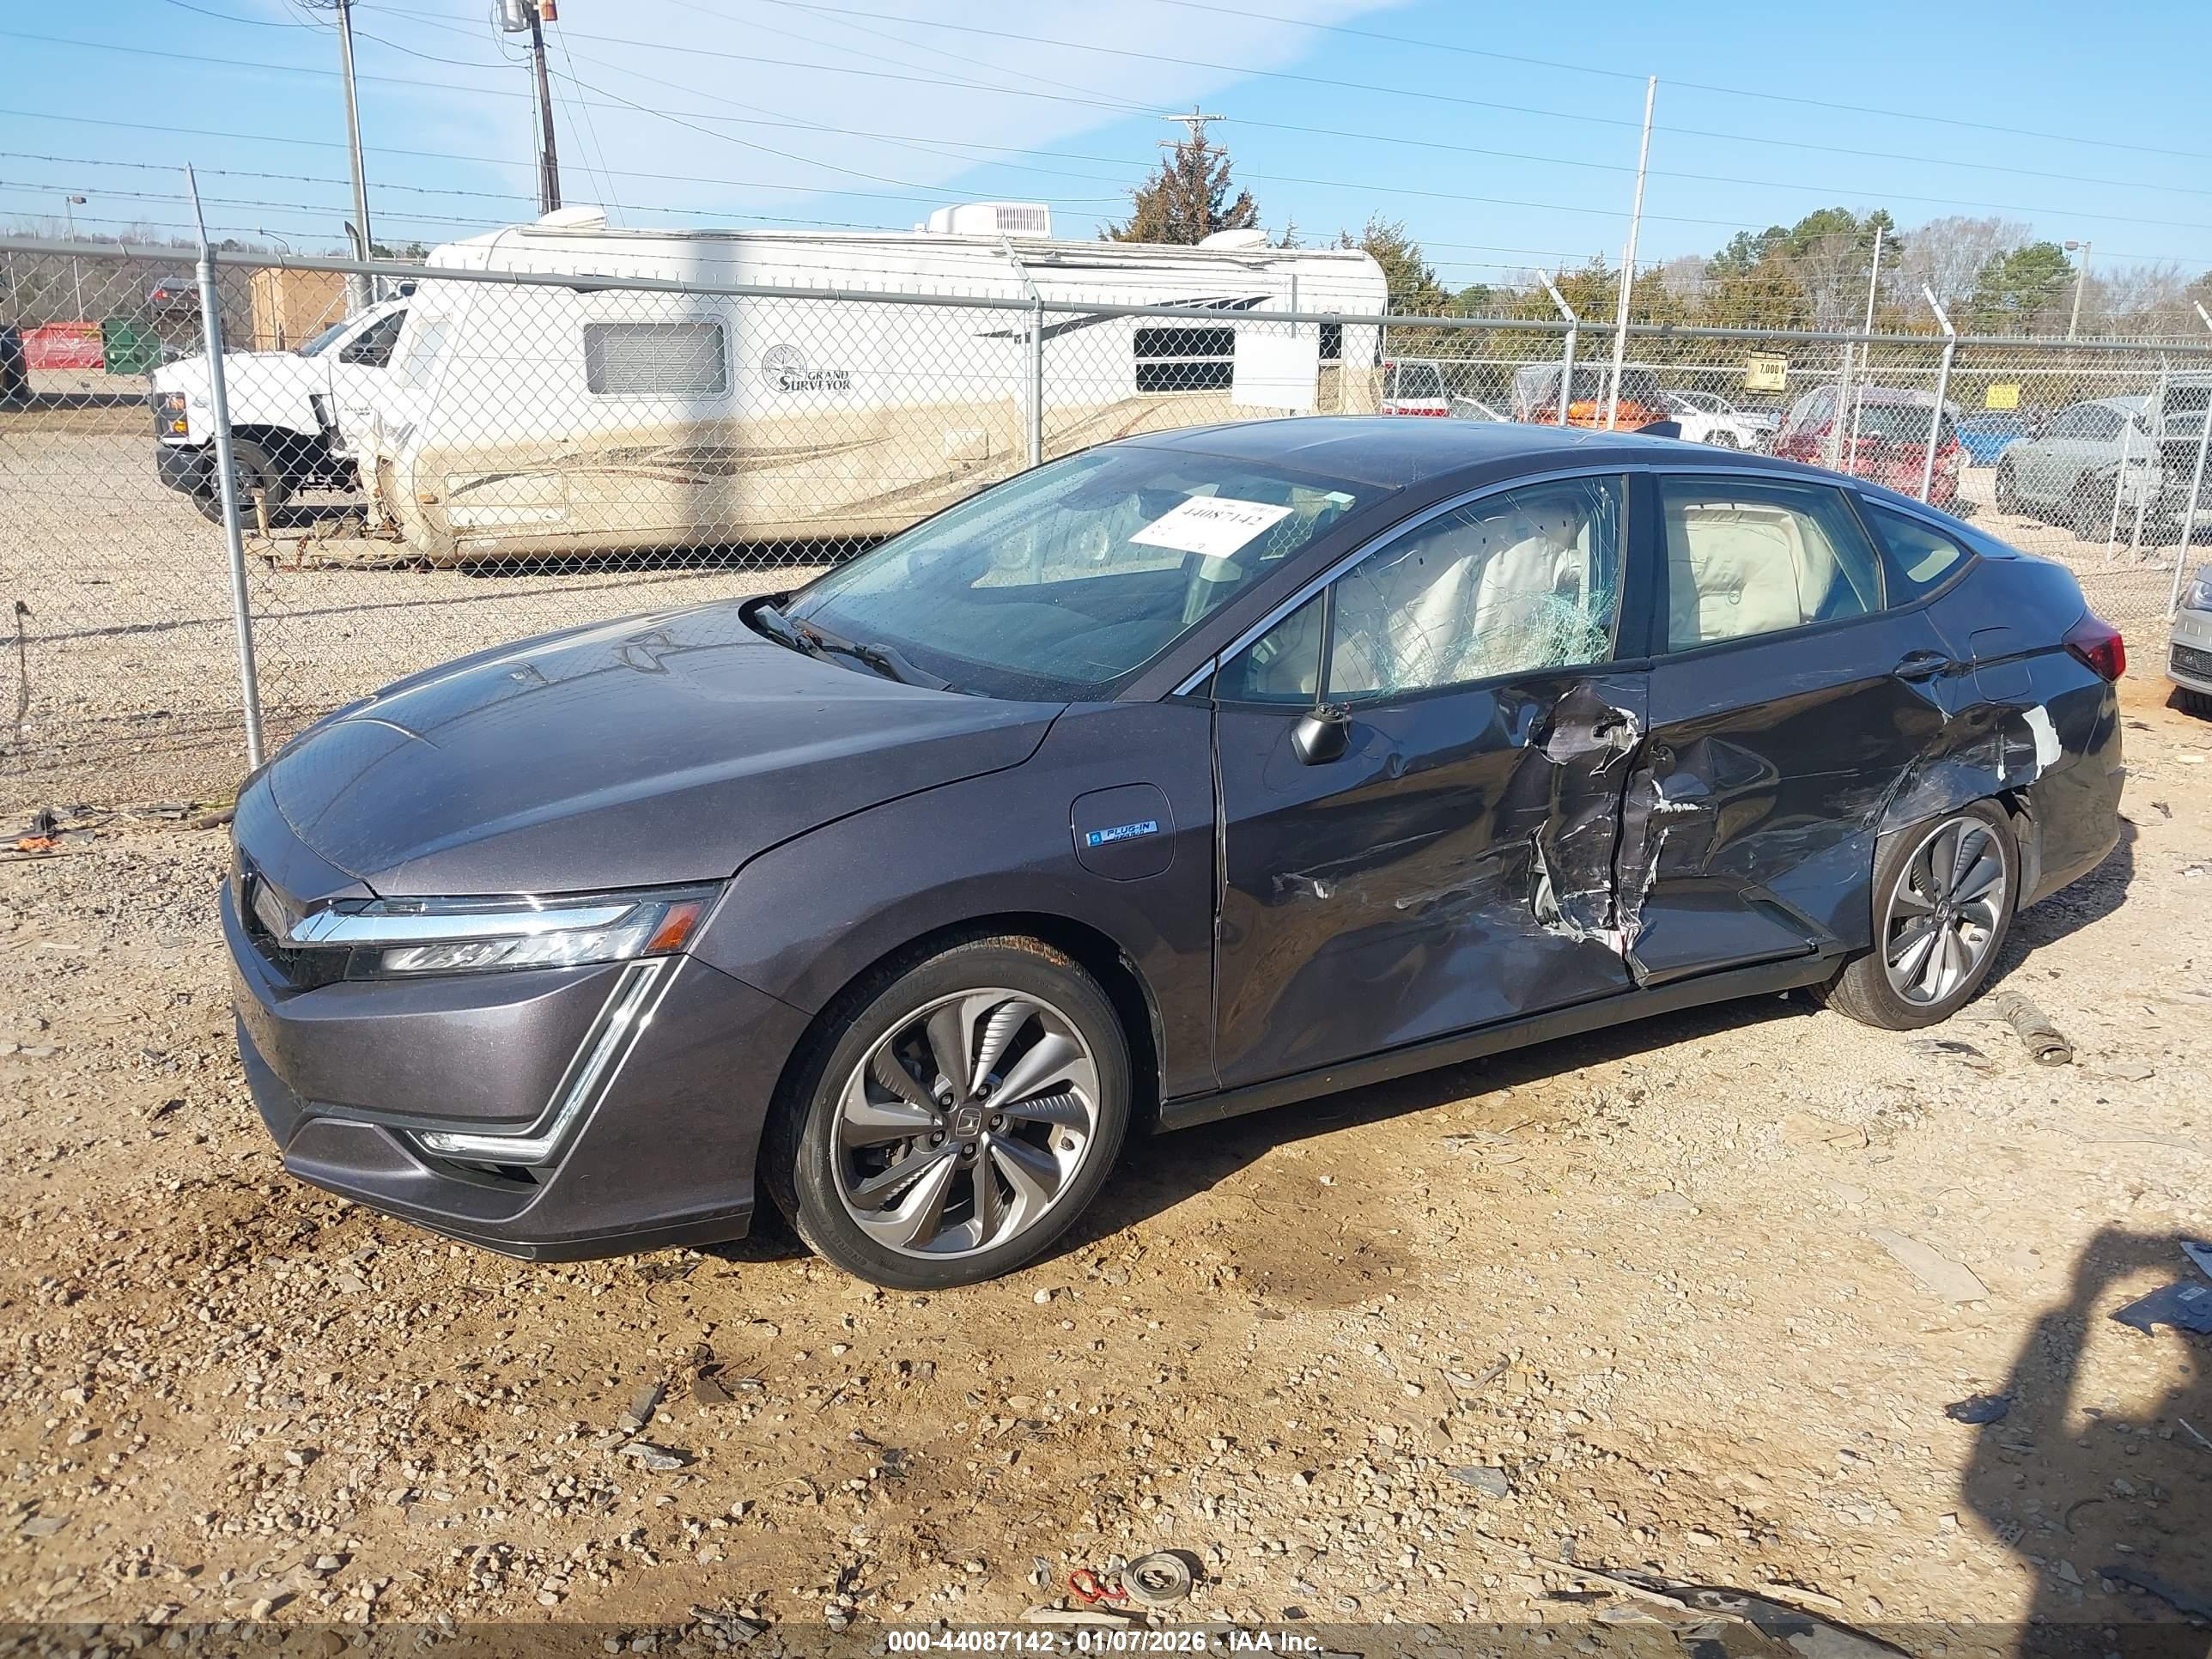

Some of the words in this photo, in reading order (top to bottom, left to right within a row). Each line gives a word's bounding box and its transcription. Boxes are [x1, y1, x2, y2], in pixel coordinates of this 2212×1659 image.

[808, 370, 849, 380] GRAND
[1760, 363, 1780, 375] 7,000
[1782, 365, 1786, 374] V
[780, 375, 851, 392] SURVEYOR
[1182, 507, 1263, 526] 44087142
[1107, 822, 1150, 837] PLUG-IN
